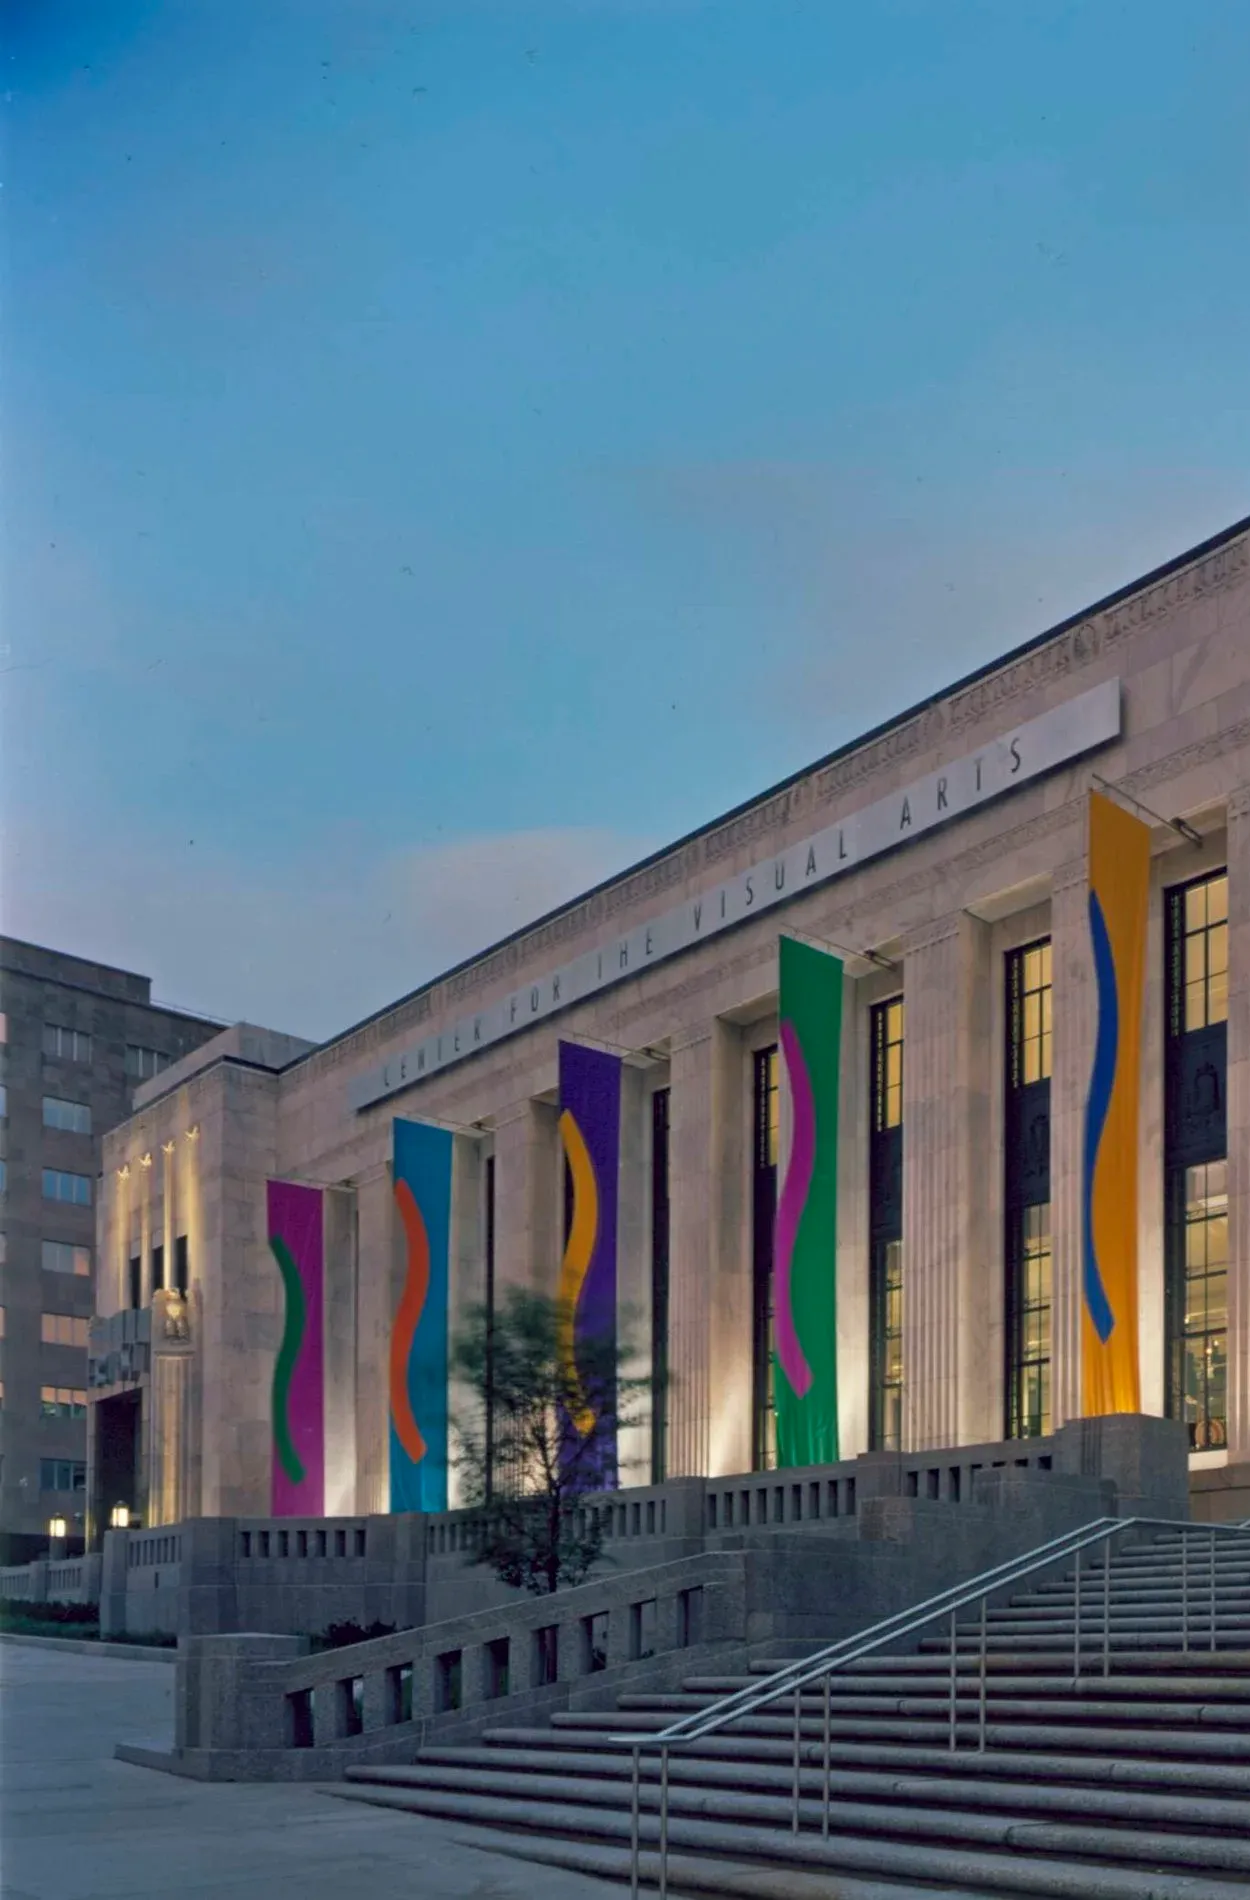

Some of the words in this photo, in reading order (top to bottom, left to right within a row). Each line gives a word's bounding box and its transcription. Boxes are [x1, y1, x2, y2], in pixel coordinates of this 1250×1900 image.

[510, 974, 560, 1023] FOR
[692, 828, 848, 931] VISUAL
[900, 736, 1022, 830] ARTS
